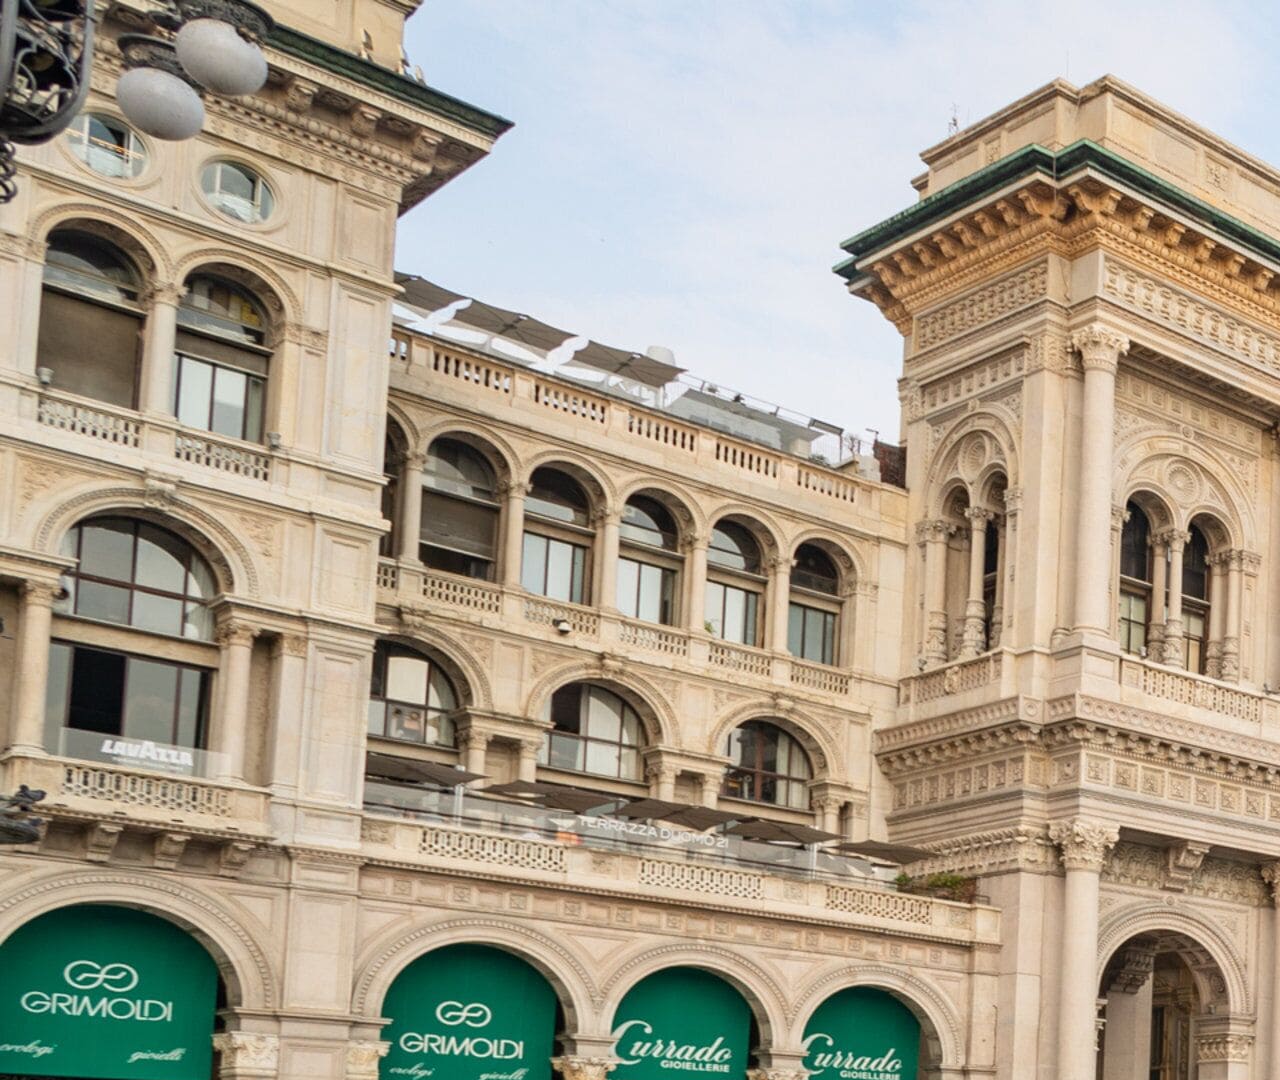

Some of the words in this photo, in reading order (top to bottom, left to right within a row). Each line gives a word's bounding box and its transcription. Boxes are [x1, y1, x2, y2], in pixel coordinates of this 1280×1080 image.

[101, 739, 193, 767] LAVAZZA
[20, 991, 173, 1022] GRIMOLDI
[399, 1032, 525, 1059] GRIMOLDI
[610, 1019, 733, 1065] Currado
[801, 1033, 902, 1075] Currado
[660, 1059, 731, 1073] GIOIELLERIE
